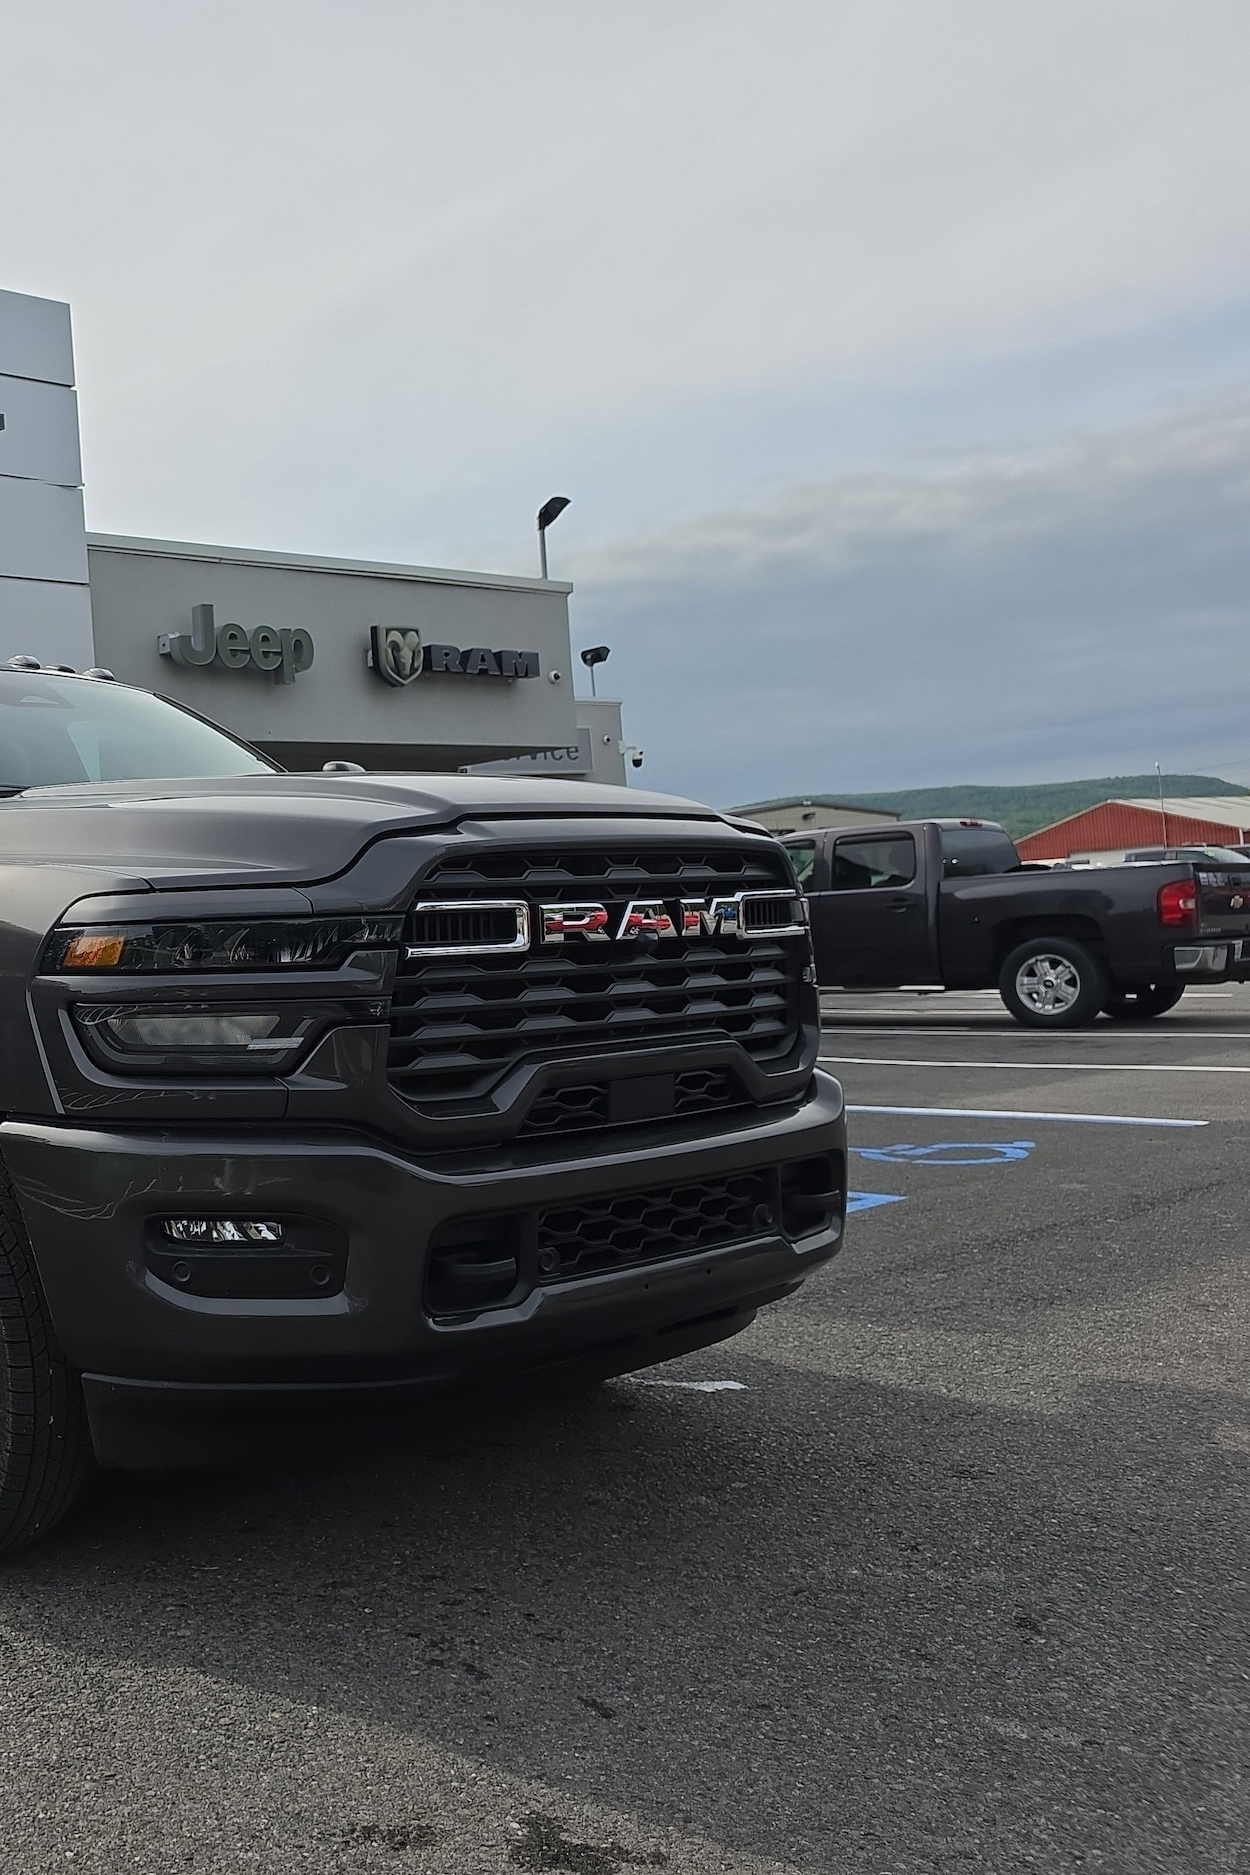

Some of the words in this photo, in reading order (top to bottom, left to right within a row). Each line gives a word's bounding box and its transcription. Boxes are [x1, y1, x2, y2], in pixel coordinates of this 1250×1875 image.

[170, 604, 315, 684] Jeep
[424, 645, 540, 678] RAM
[539, 896, 740, 945] RAM
